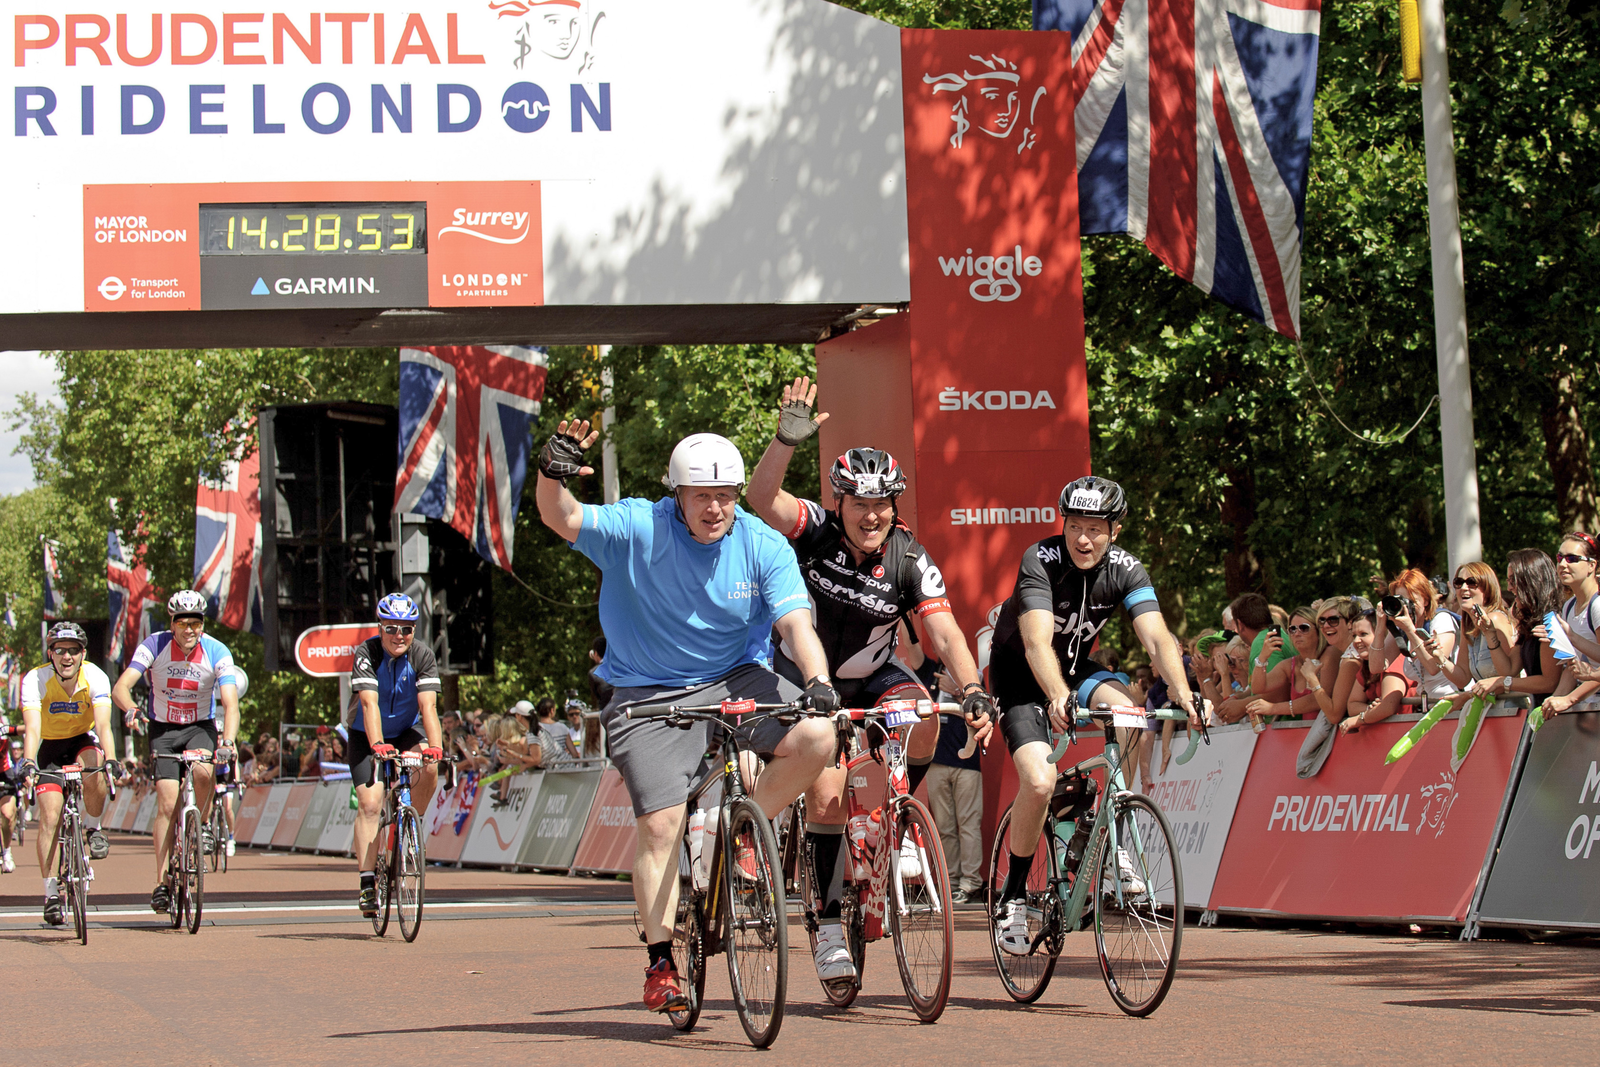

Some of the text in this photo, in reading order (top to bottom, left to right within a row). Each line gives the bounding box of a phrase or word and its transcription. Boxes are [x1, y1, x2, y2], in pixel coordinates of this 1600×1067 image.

[14, 13, 486, 67] PRUDENTIAL
[14, 81, 612, 136] RIDELONDON
[95, 216, 148, 229] MAYOR
[452, 208, 528, 229] Surrey
[95, 229, 187, 243] OF LONDON
[227, 214, 414, 251] 14.28.53
[938, 245, 1042, 302] wiggle
[131, 278, 178, 288] Transport
[131, 289, 185, 298] for London
[938, 387, 1056, 411] ŠKODA
[712, 462, 718, 479] 1
[1072, 496, 1098, 508] 16824
[951, 507, 1056, 525] SHIMANO
[1037, 546, 1061, 564] sky
[1109, 550, 1140, 572] sky
[809, 569, 899, 614] cervélo
[857, 573, 893, 592] zipvit
[728, 590, 760, 600] LONDO
[308, 645, 360, 658] PRUDEN
[167, 665, 200, 678] Sparks
[736, 715, 741, 726] 1
[1267, 794, 1410, 832] PRUDENTIAL
